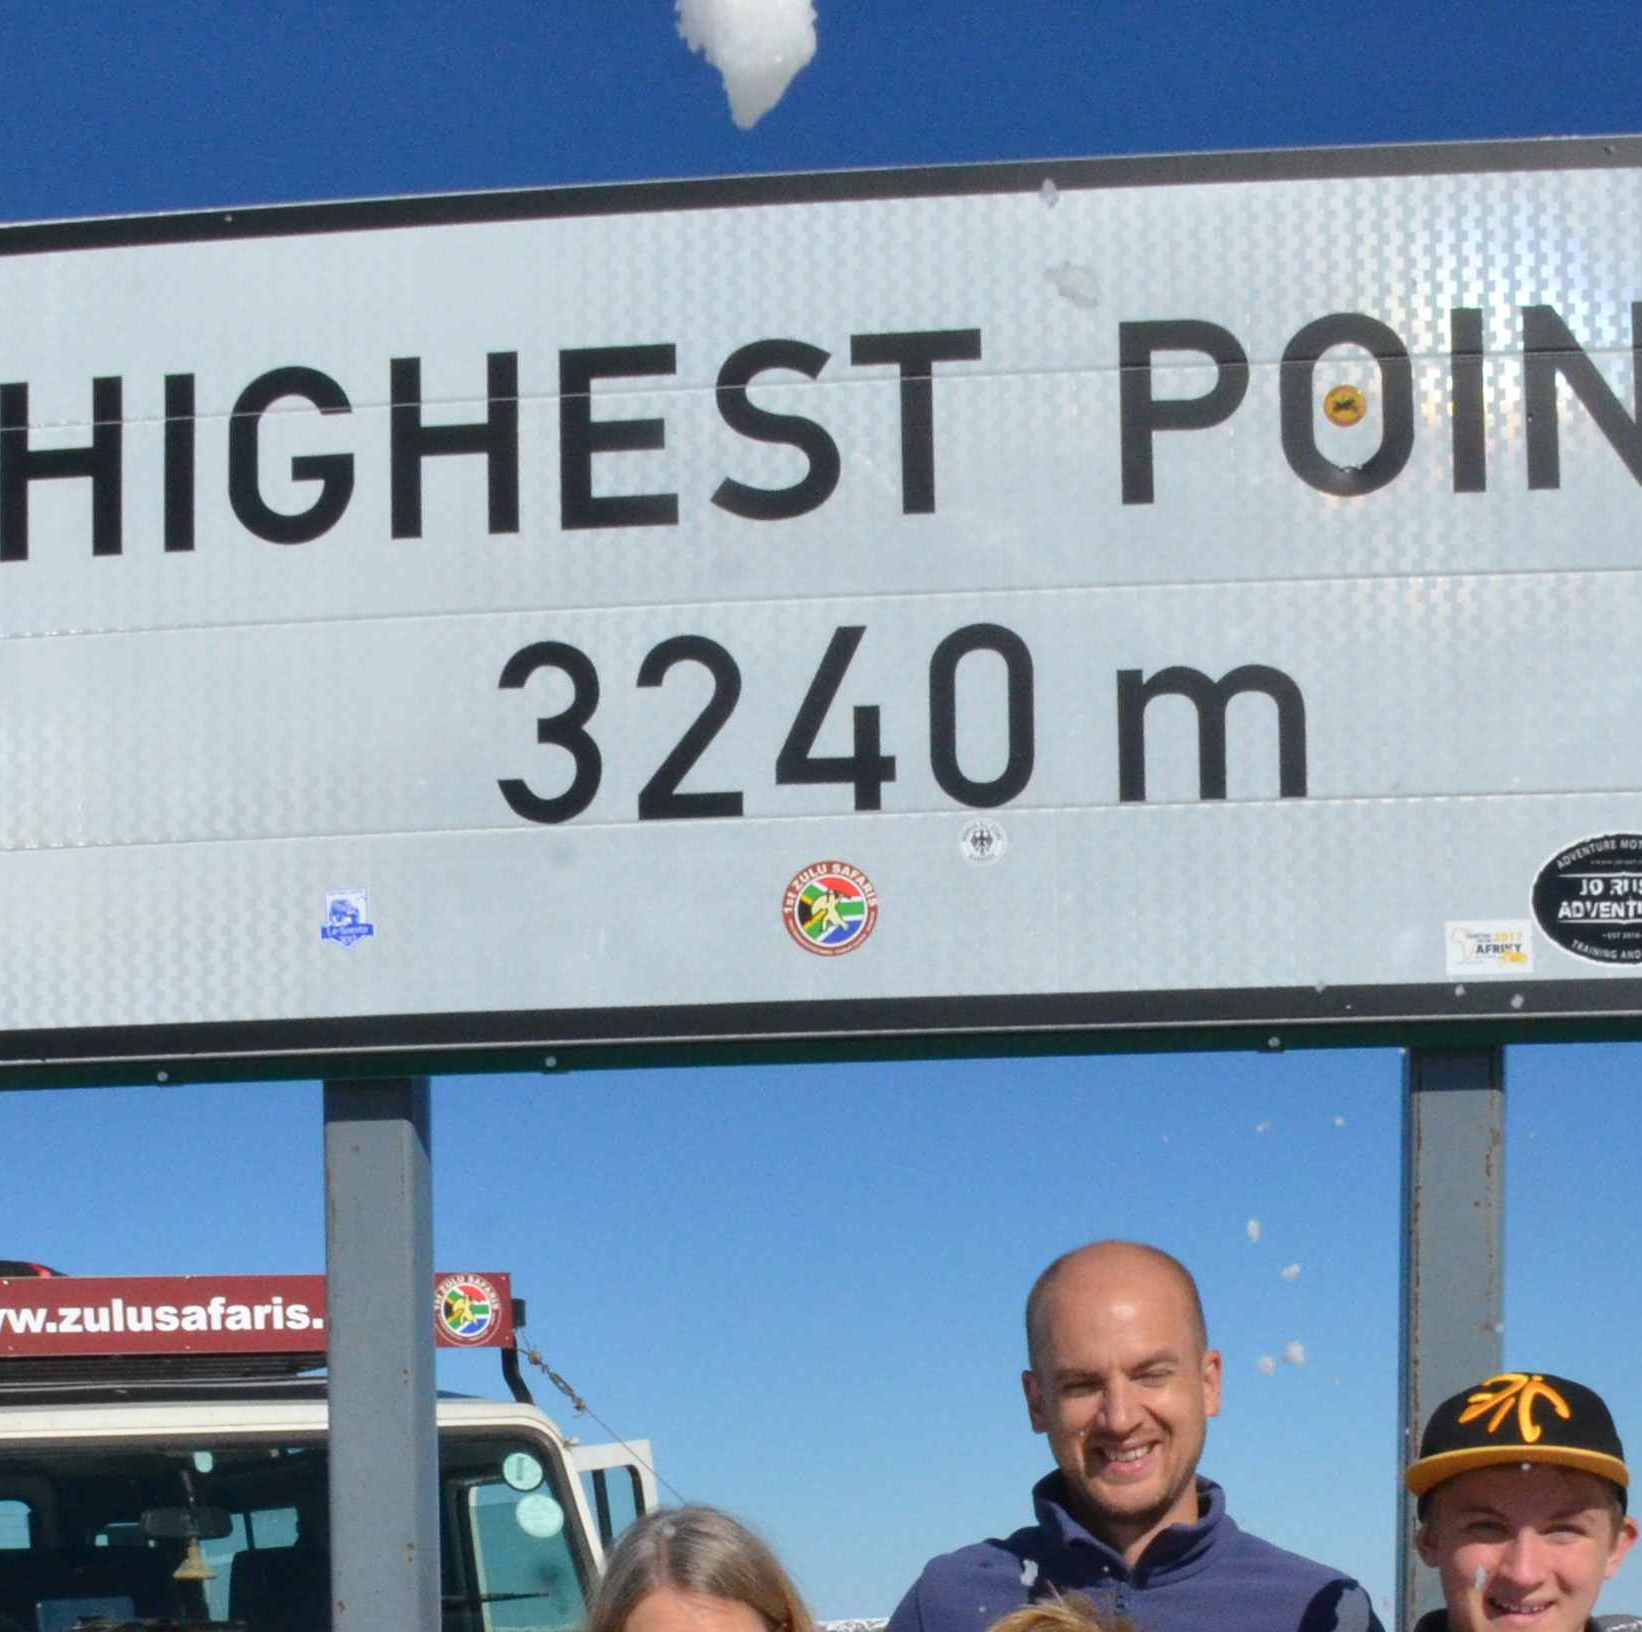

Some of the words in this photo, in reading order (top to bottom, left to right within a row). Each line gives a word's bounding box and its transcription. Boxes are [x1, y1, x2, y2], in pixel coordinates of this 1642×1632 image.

[0, 329, 982, 562] HIGHEST
[497, 624, 1035, 824] 3240
[1116, 663, 1308, 802] m
[1557, 839, 1617, 870] ADVENTURE
[791, 863, 827, 891] ZULU
[831, 863, 878, 907] SAFARIS
[1579, 878, 1604, 896] JO
[1571, 939, 1618, 960] TRAINING
[1620, 948, 1642, 960] AND
